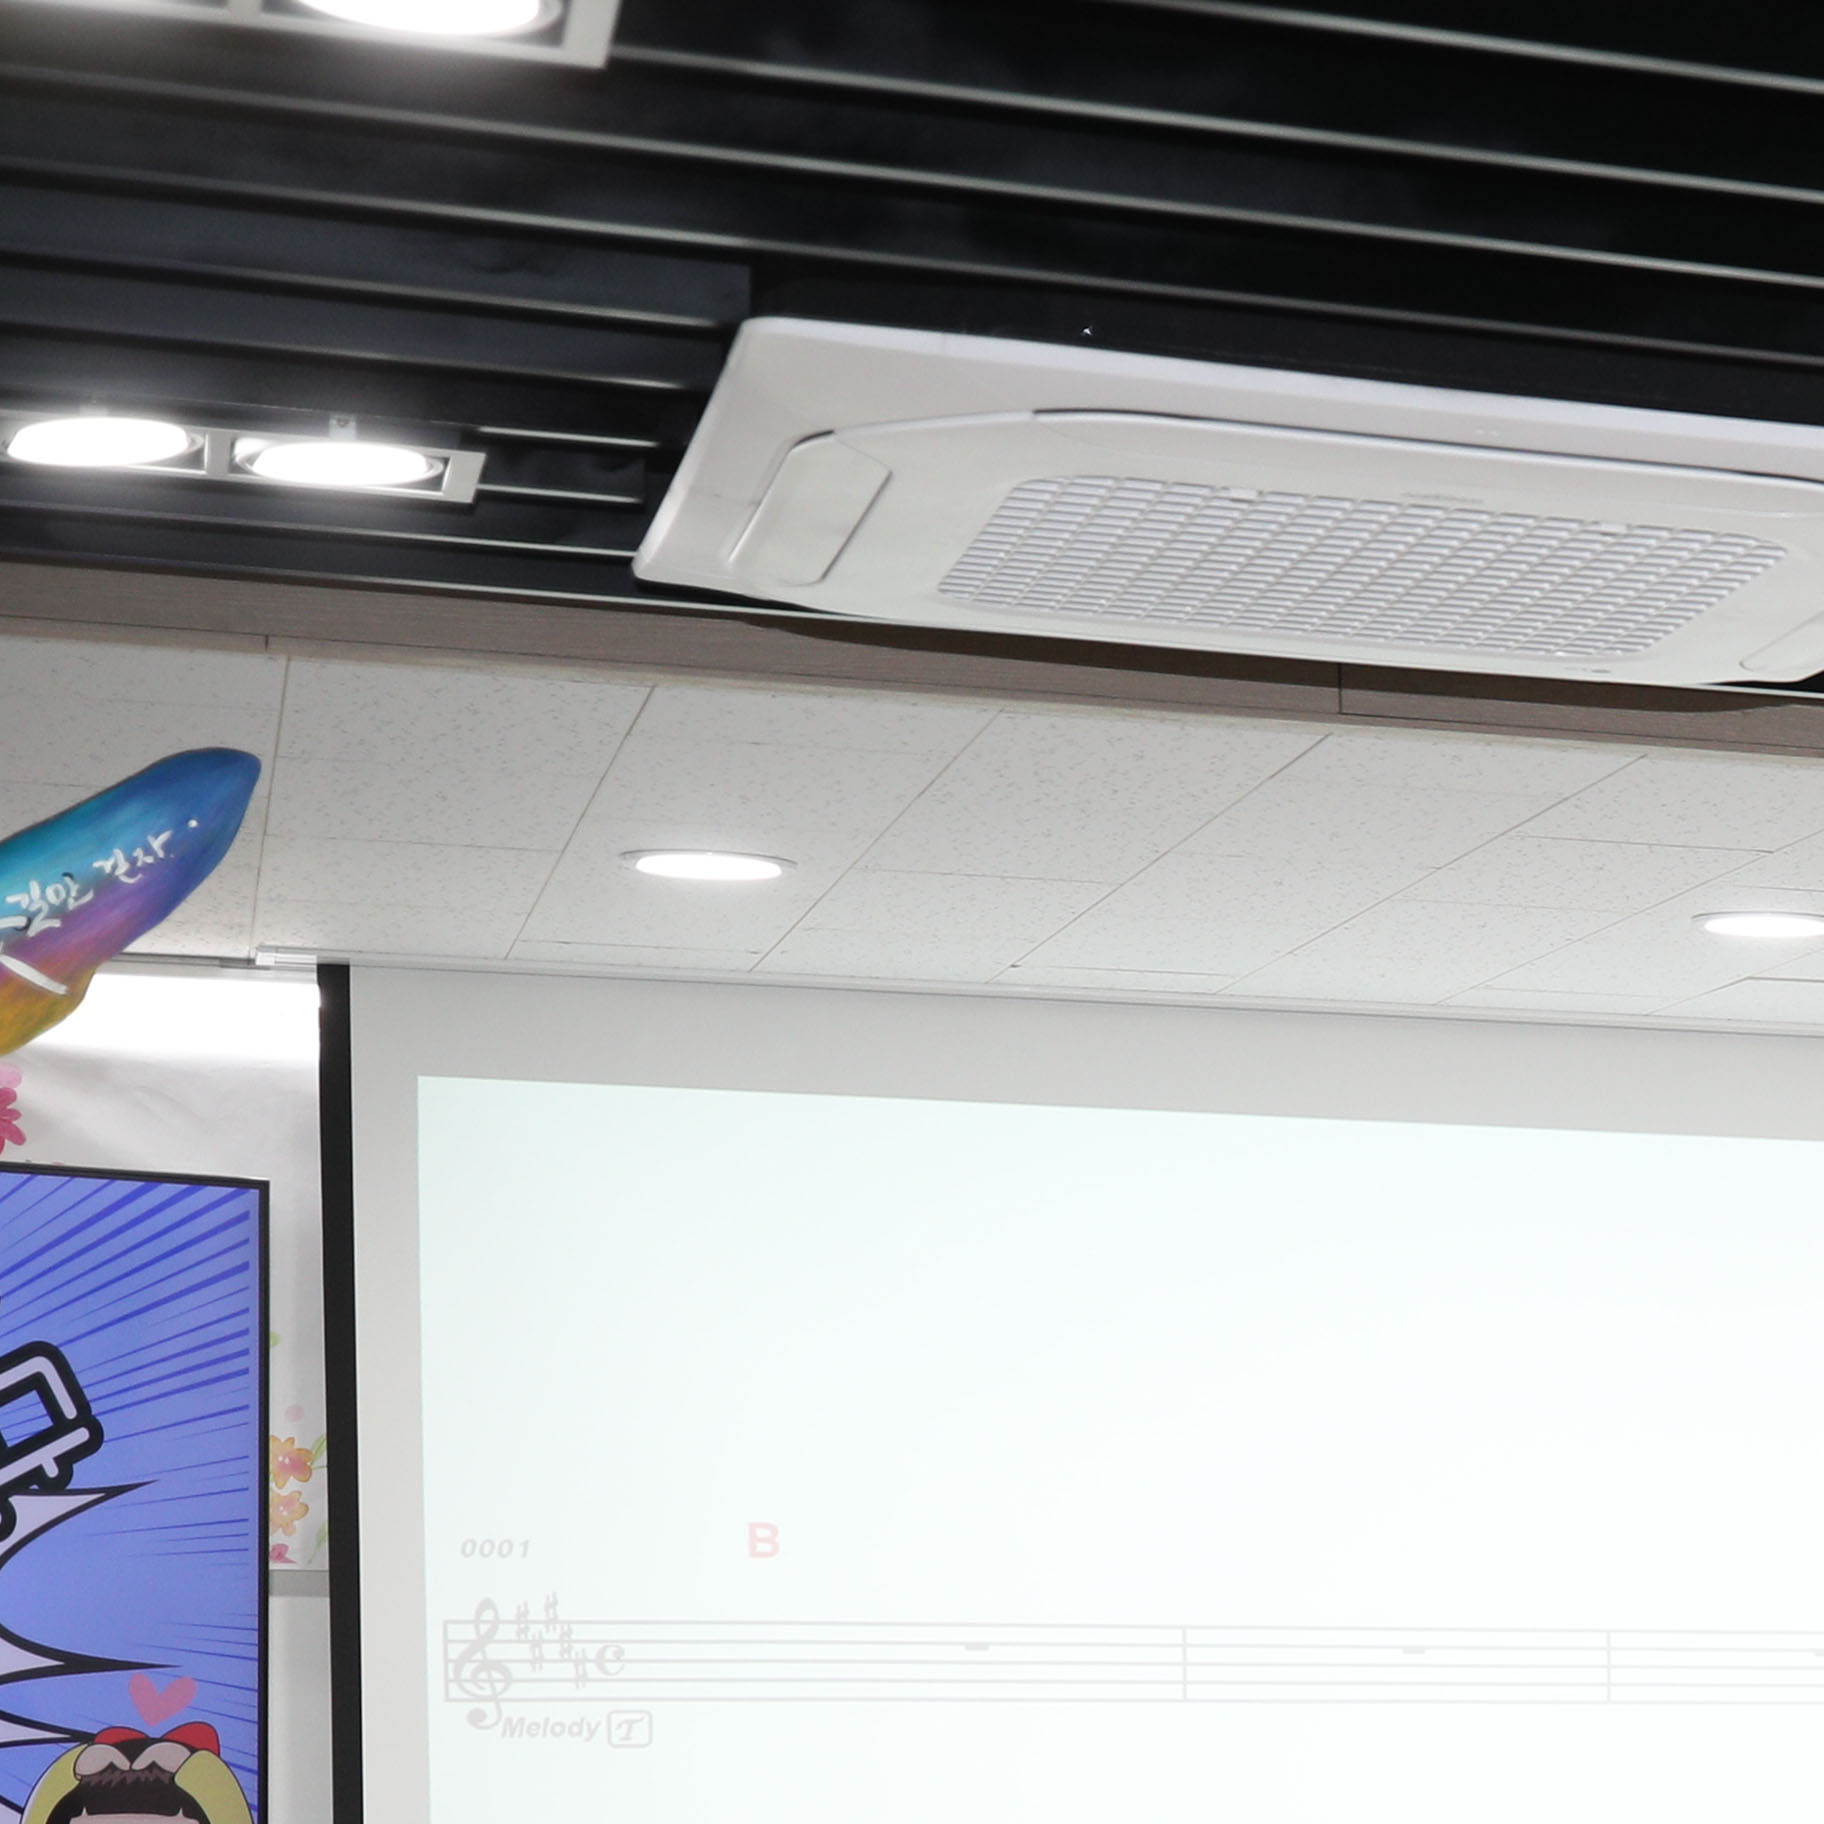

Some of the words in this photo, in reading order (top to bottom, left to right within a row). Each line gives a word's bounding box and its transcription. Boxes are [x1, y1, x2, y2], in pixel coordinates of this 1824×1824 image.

[460, 1538, 532, 1560] 0001
[748, 1522, 781, 1560] B
[499, 1709, 602, 1744] Melody
